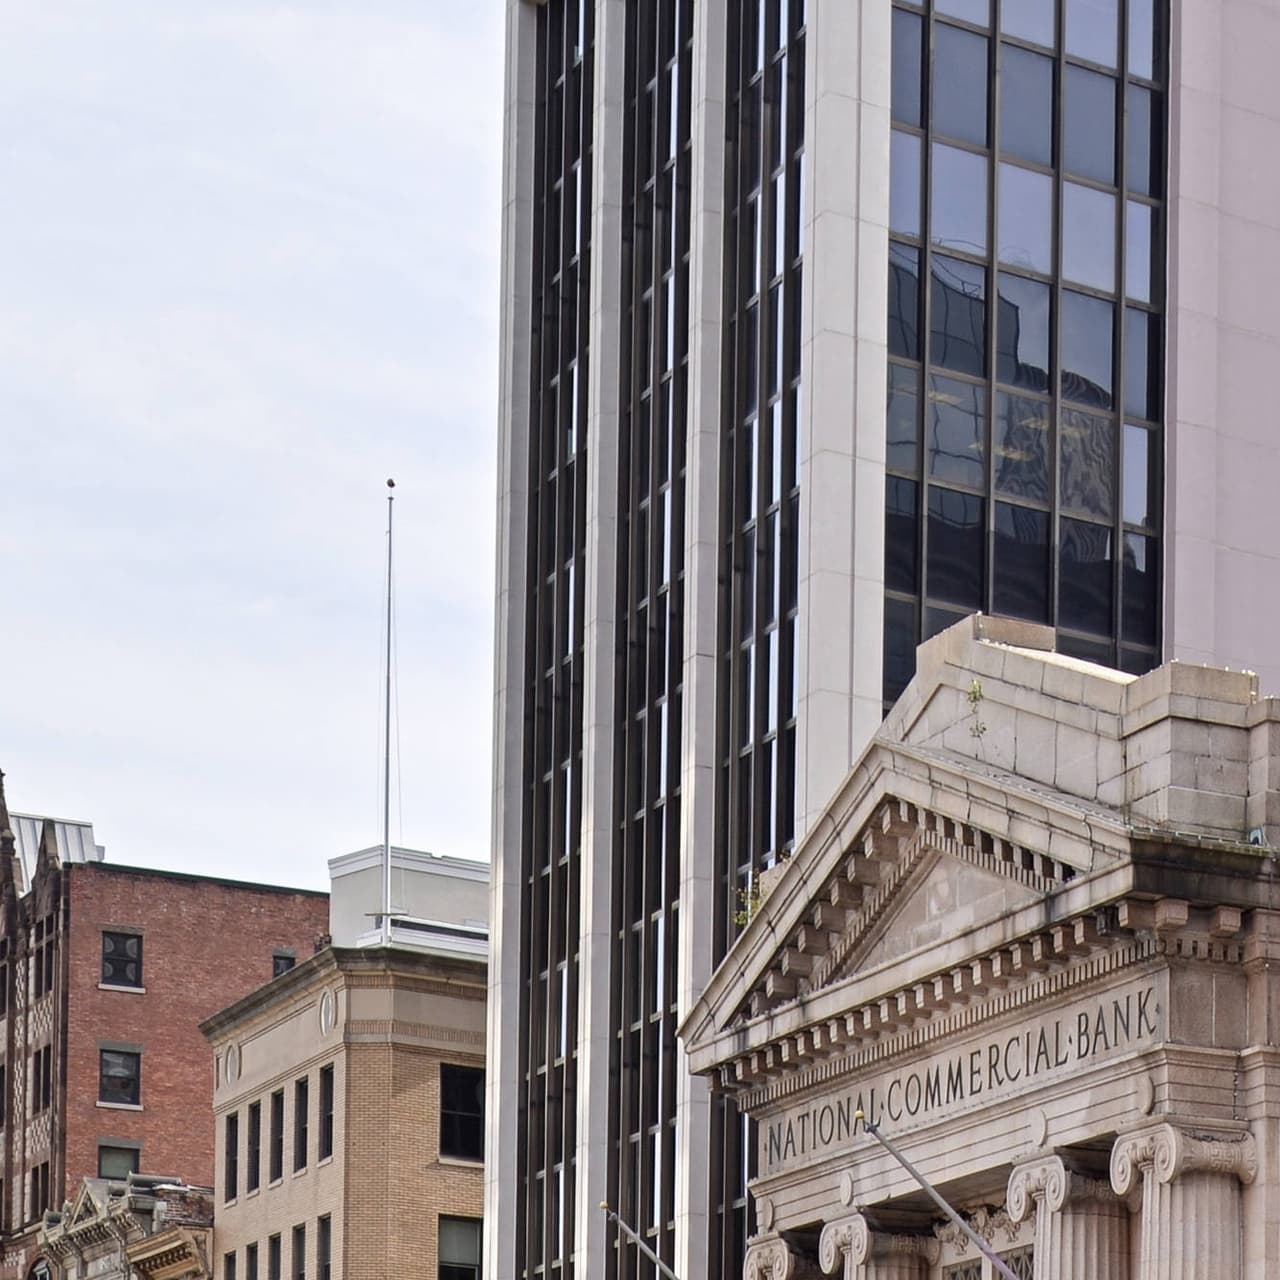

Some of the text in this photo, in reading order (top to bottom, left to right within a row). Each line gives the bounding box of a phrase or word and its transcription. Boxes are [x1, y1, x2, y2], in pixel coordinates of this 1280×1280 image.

[768, 987, 1157, 1166] NATIONAL COMMERCIAL BANK
